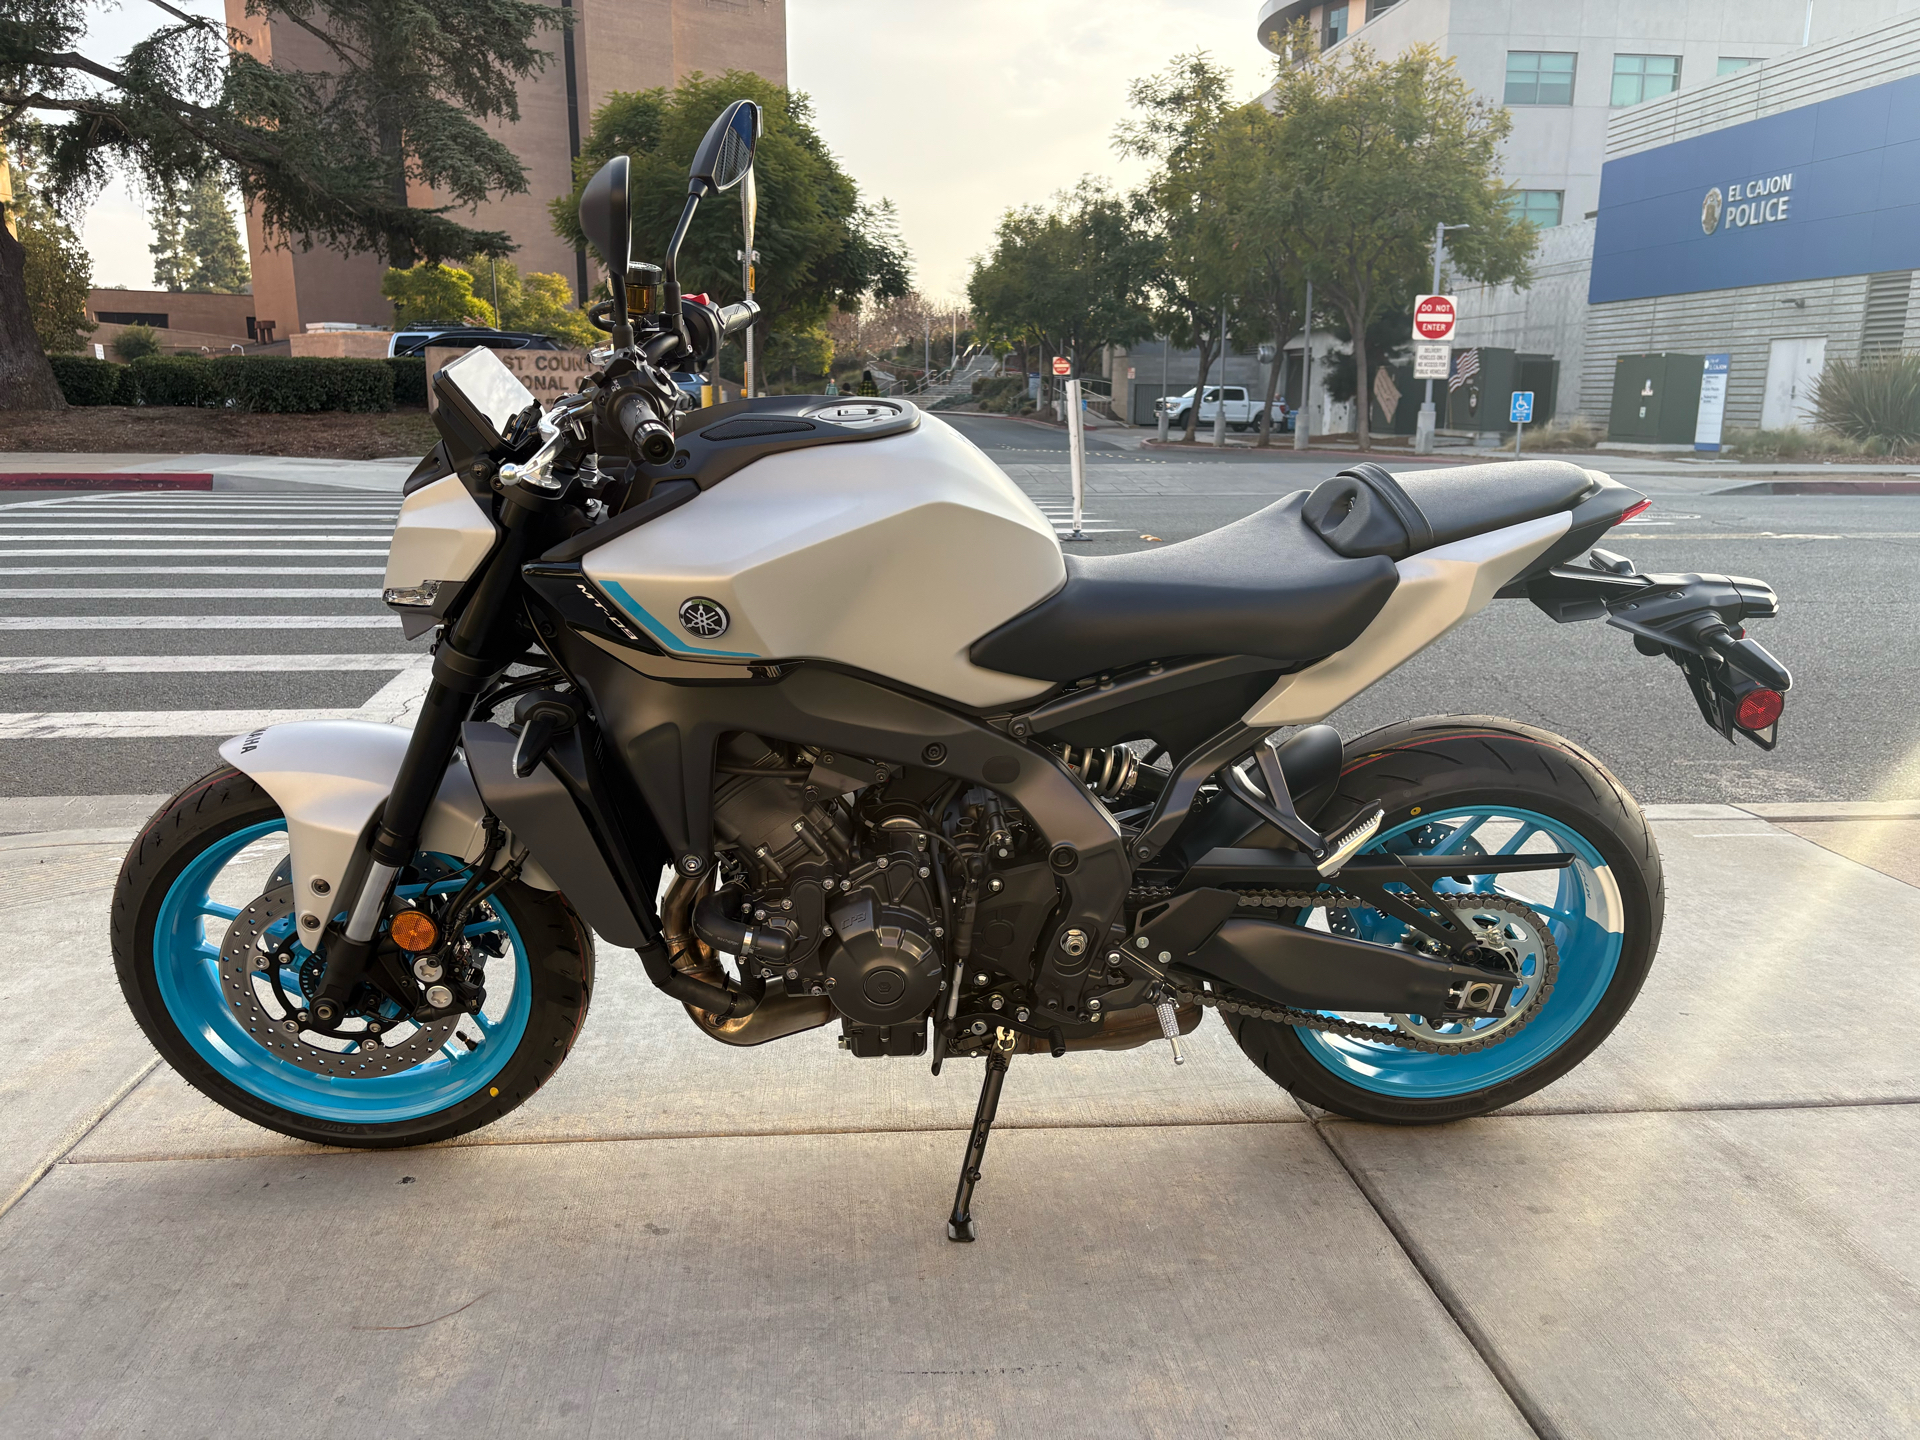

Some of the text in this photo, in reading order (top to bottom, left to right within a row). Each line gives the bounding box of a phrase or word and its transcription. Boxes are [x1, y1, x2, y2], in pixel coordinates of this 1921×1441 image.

[1728, 173, 1793, 202] EL CAJON
[1725, 196, 1790, 229] POLICE
[1421, 304, 1450, 312] DO NOT
[1422, 323, 1446, 332] ENTER
[535, 355, 594, 372] COUNT
[576, 584, 639, 640] MT-09
